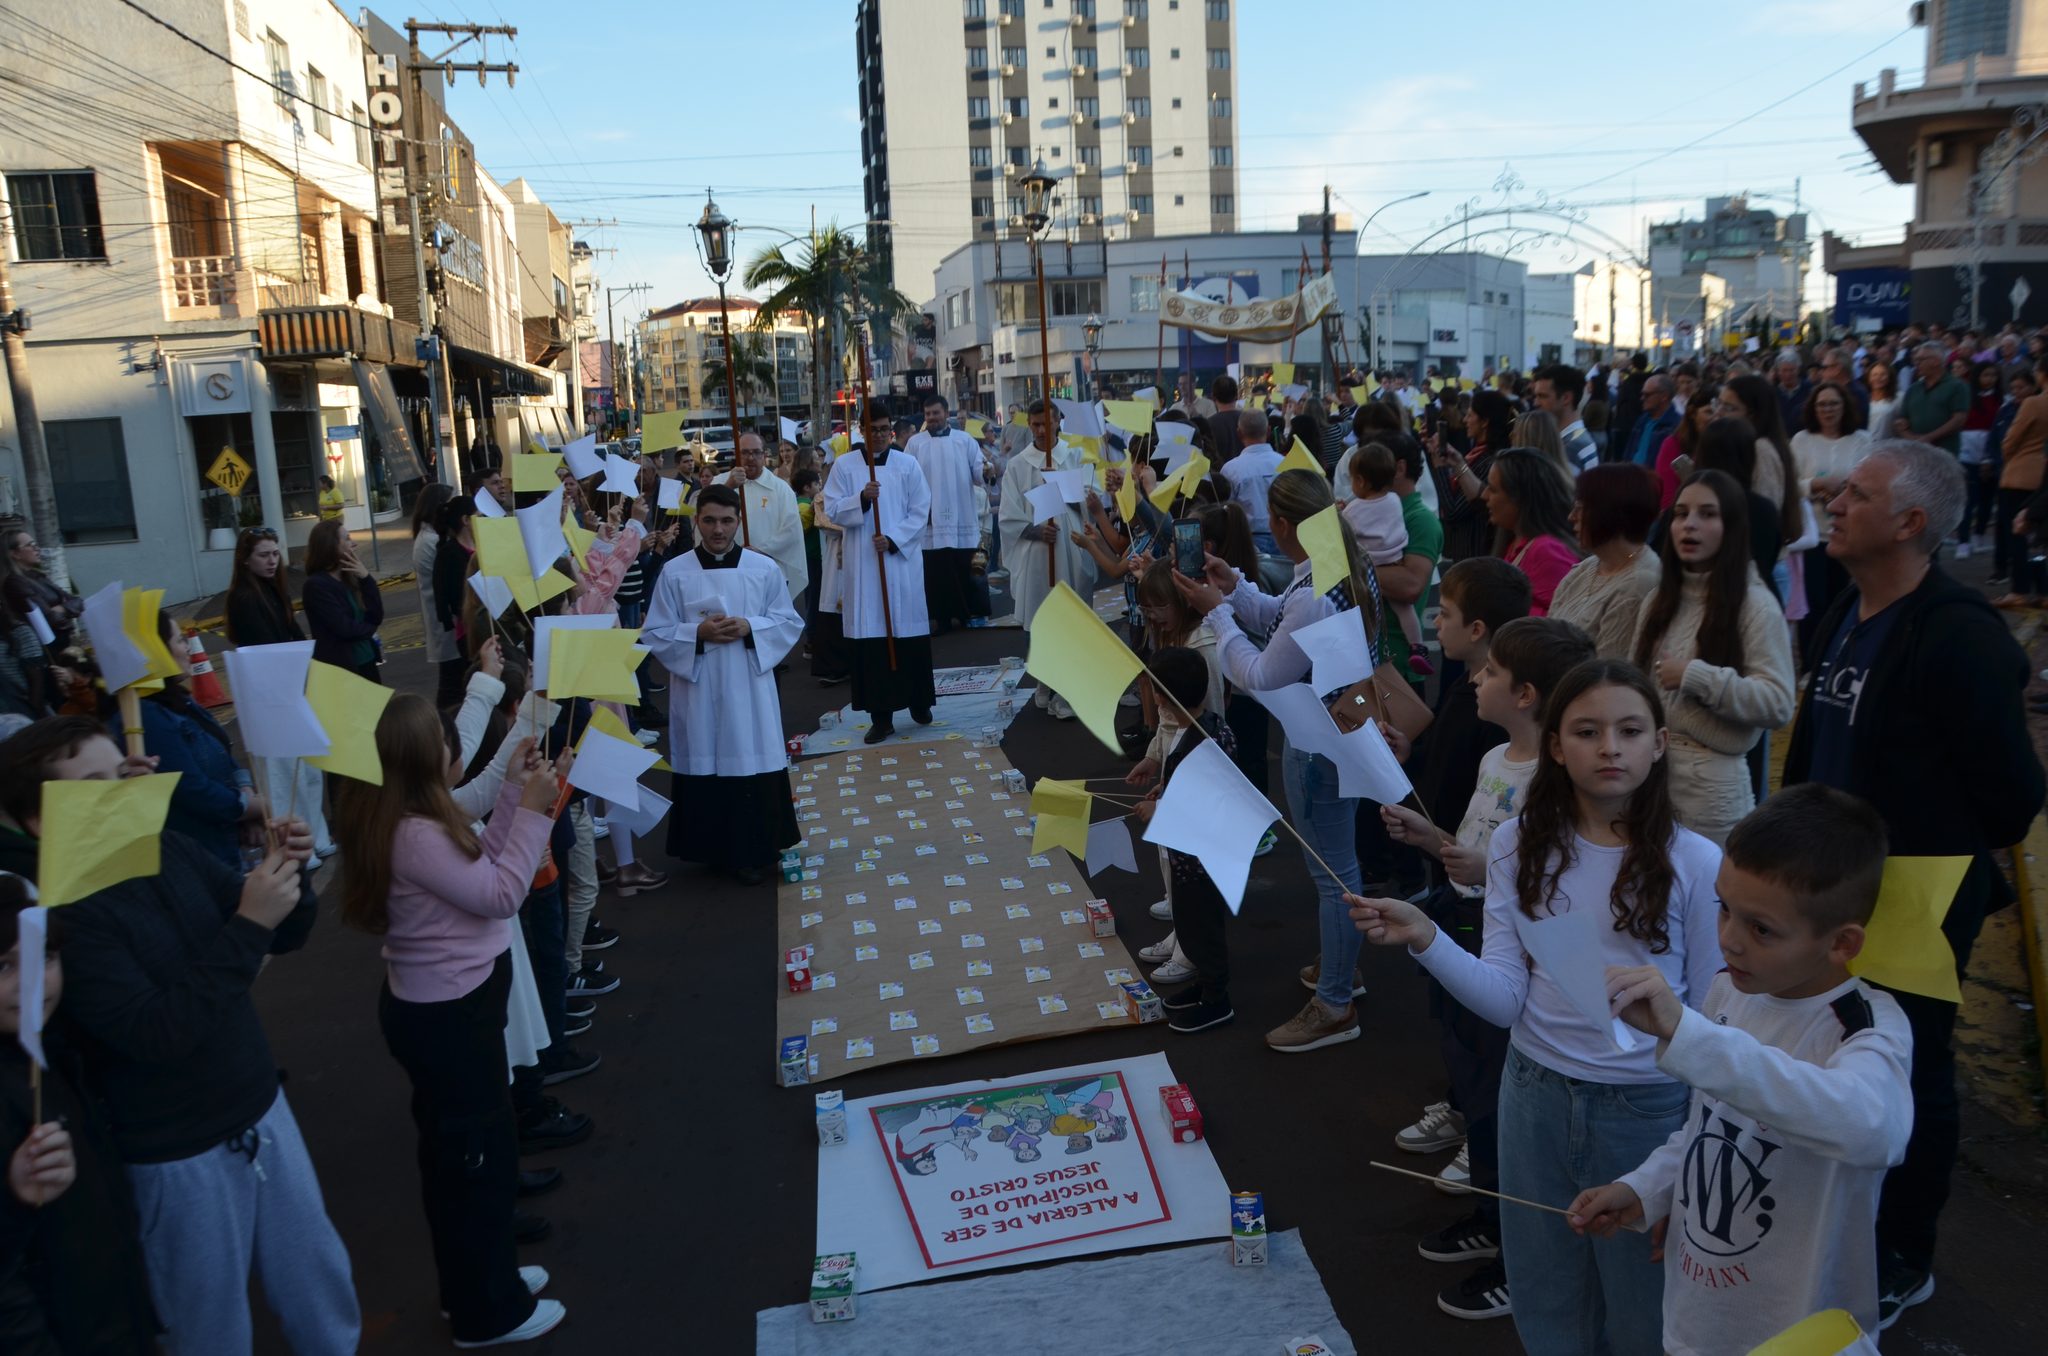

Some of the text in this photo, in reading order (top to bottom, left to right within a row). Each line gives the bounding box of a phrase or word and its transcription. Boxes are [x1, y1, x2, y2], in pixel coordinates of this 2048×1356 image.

[366, 54, 410, 235] HOTEL
[950, 1161, 1101, 1202] JESUS CRISTO
[959, 1178, 1109, 1220] DISCÍPULO DE
[942, 1191, 1139, 1243] A ALEGRIA DE SER
